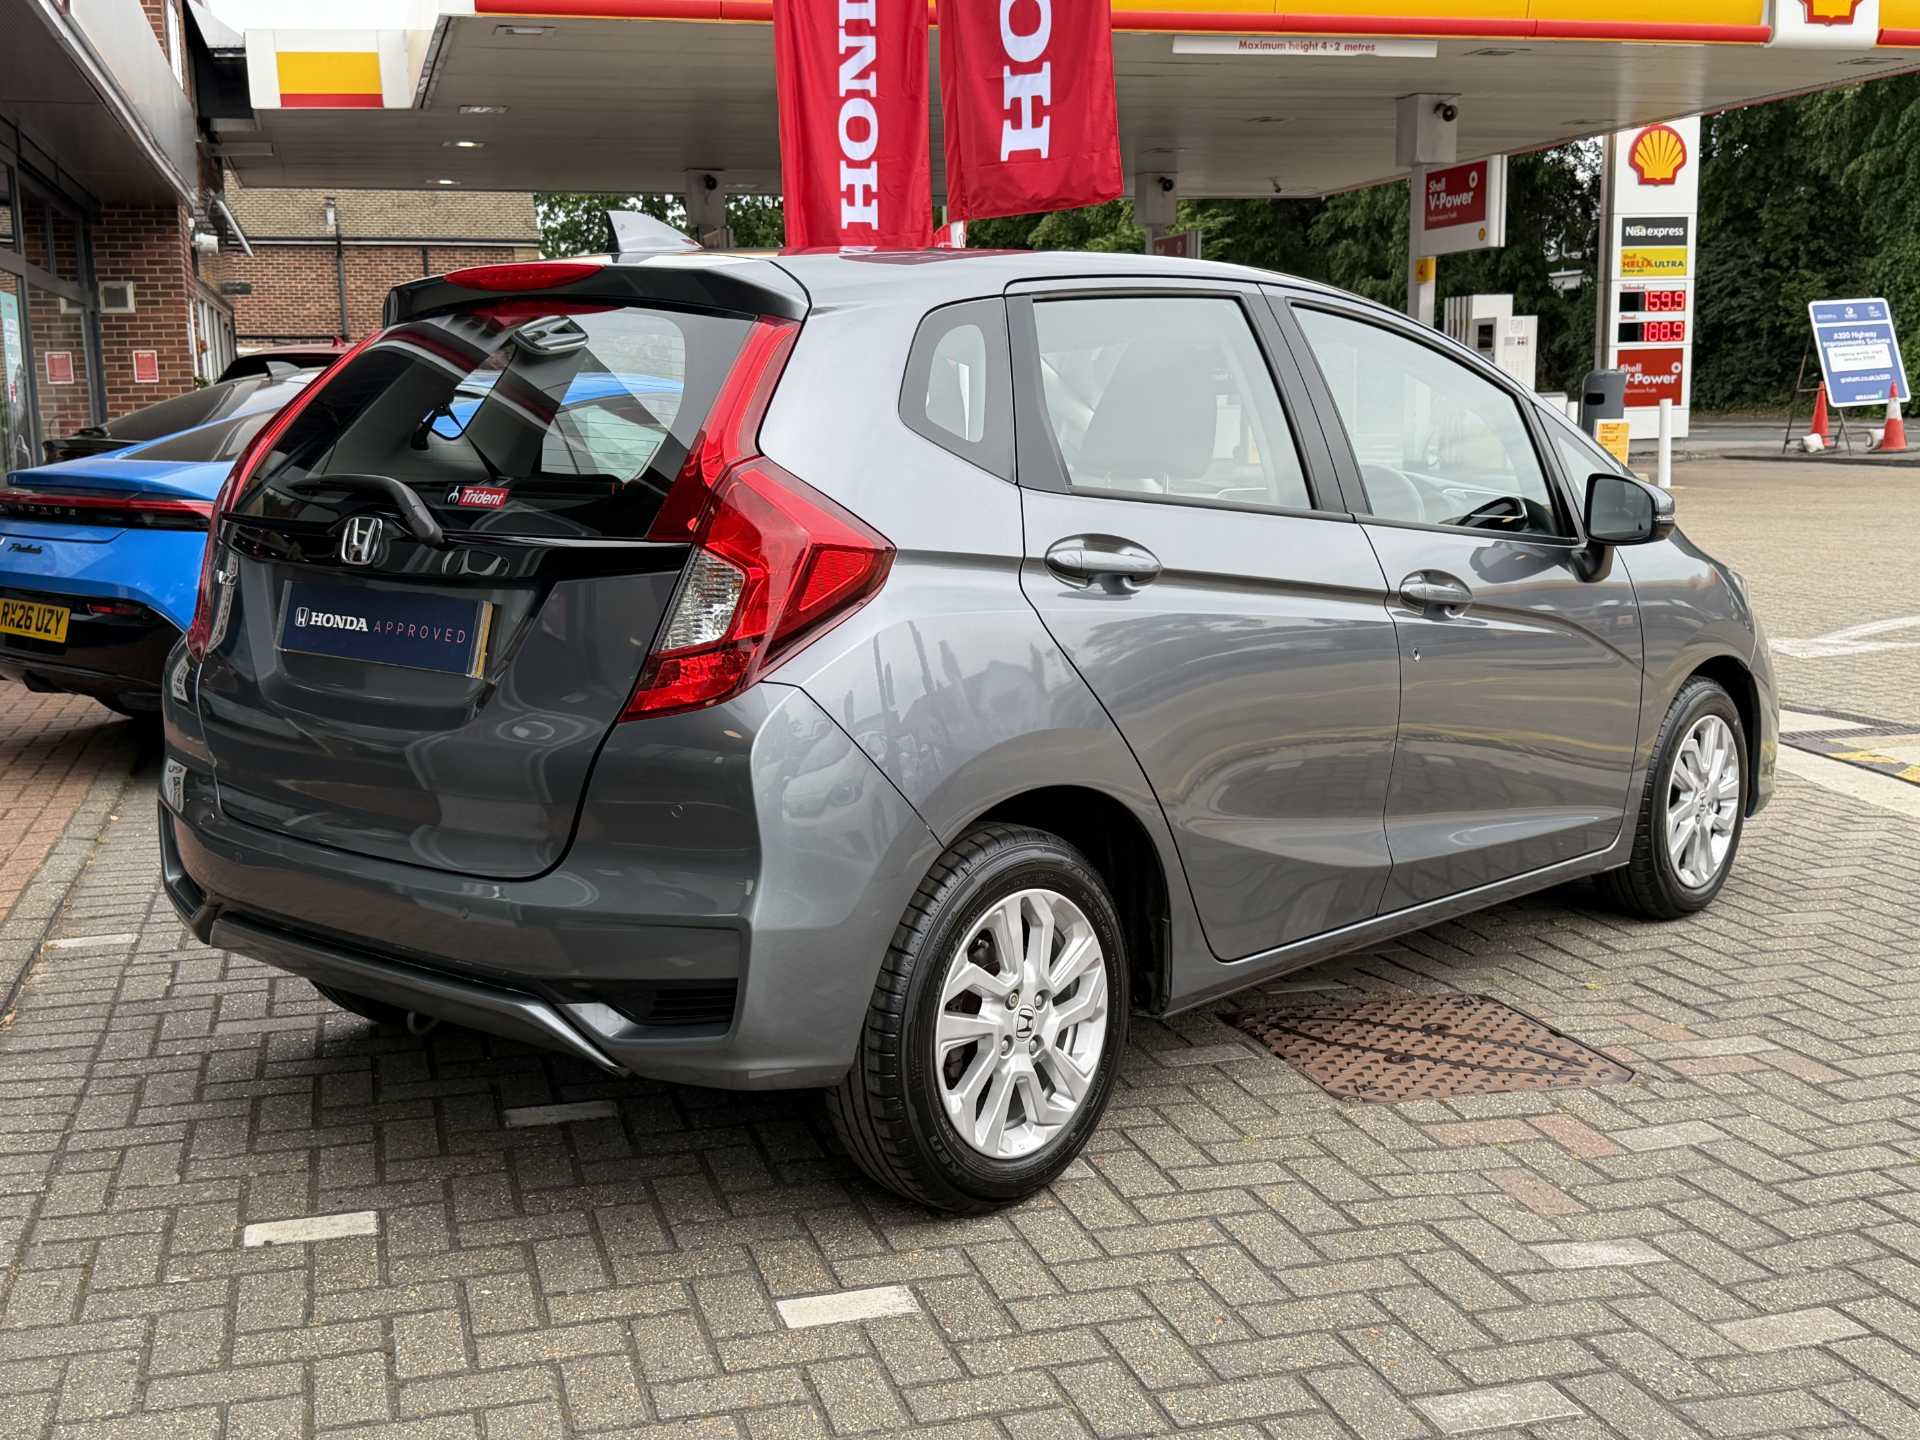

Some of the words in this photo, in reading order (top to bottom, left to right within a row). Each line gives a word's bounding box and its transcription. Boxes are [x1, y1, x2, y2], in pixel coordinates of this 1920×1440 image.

[1238, 40, 1286, 50] Maximum
[1287, 41, 1319, 53] height
[1344, 42, 1376, 51] metres
[1429, 177, 1447, 193] Shell
[1429, 191, 1474, 211] V-Power
[1647, 227, 1684, 238] express
[1654, 260, 1684, 268] ULTRA
[1645, 291, 1685, 311] 159.9
[1643, 322, 1684, 342] 188.9
[462, 488, 504, 505] Trident
[1, 602, 35, 630] RX26
[35, 607, 65, 635] UZY
[310, 612, 369, 632] HONDA
[373, 620, 466, 644] APPROVED
